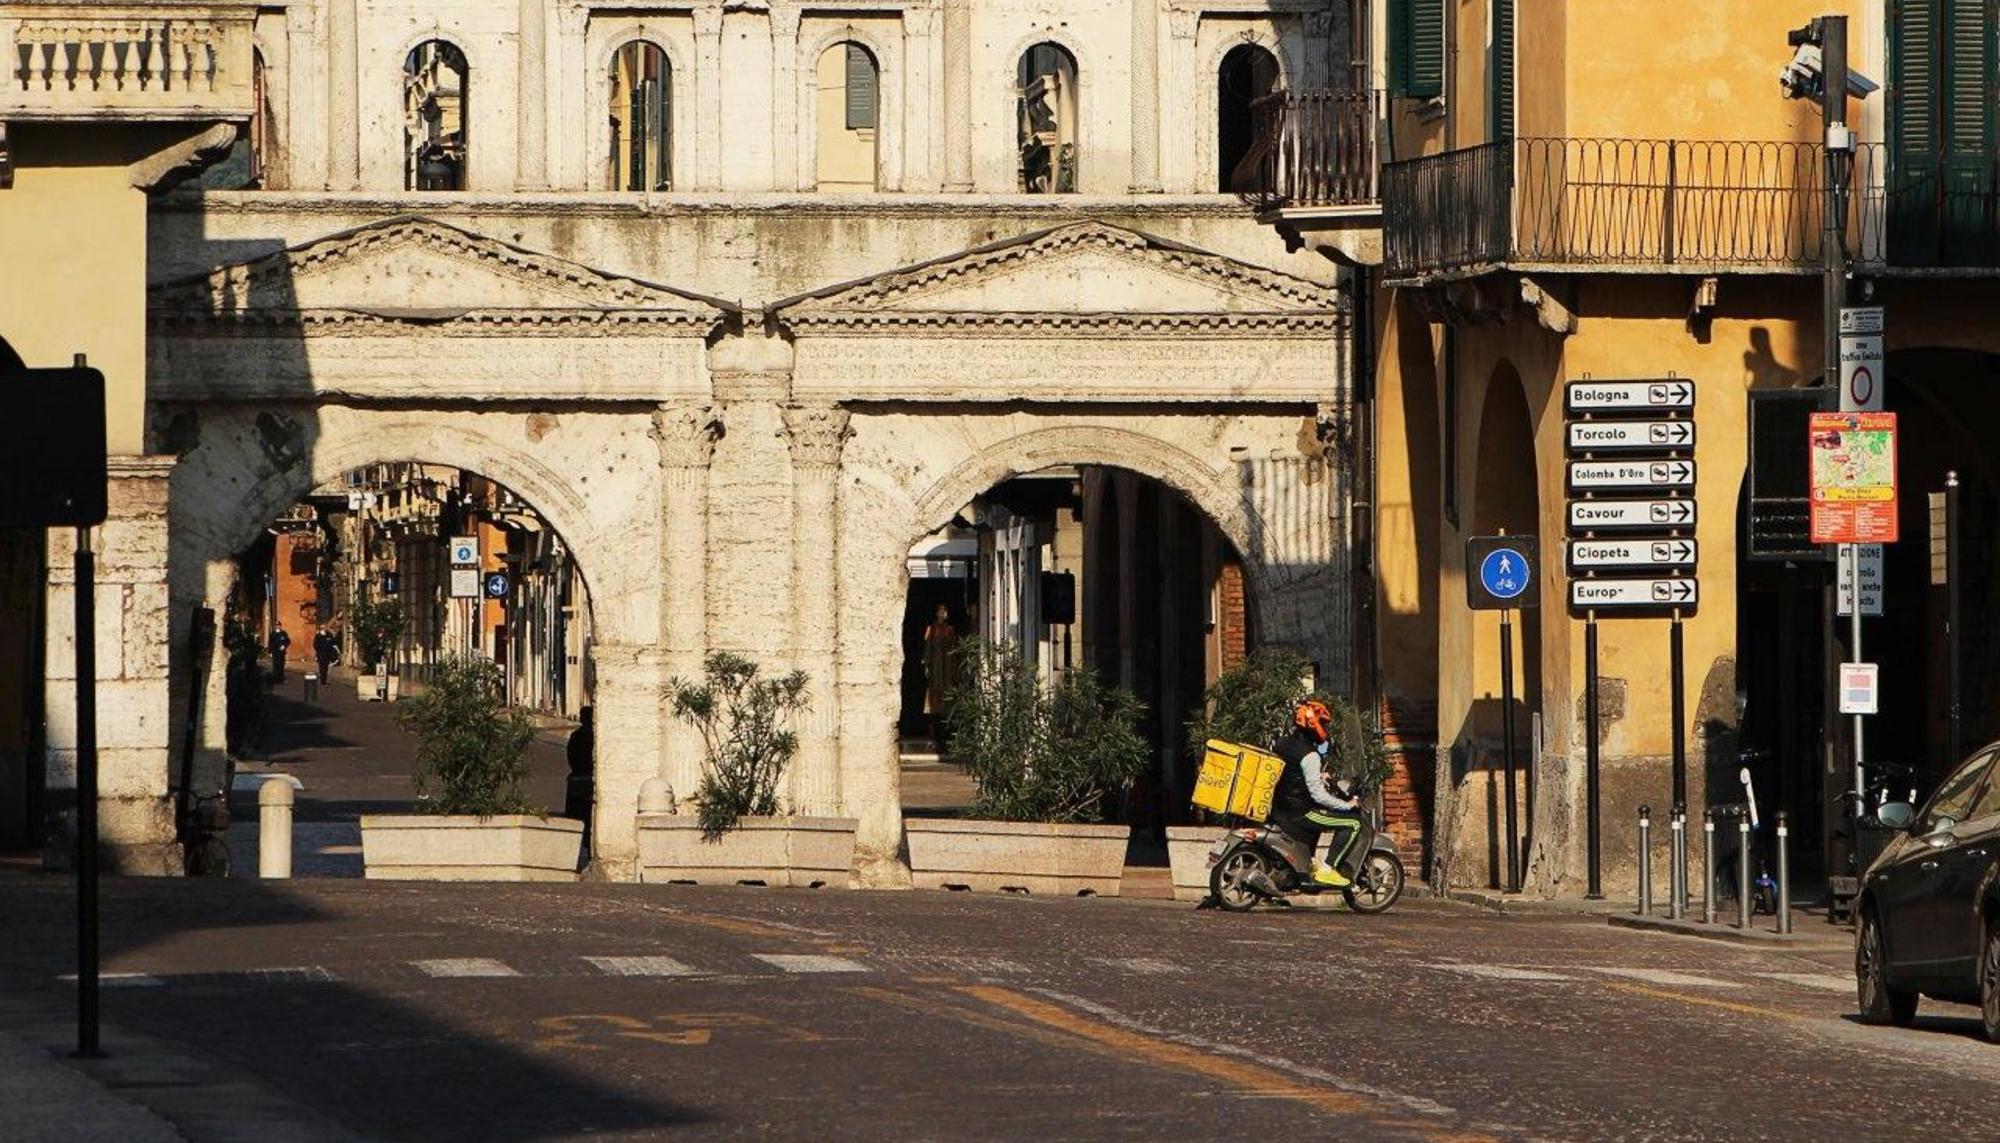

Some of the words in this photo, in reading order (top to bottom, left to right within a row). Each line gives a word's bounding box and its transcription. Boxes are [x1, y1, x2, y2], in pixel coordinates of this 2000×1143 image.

[1574, 390, 1629, 402] Bologna
[1576, 429, 1626, 440] Torcolo
[1576, 469, 1614, 479] Colomba
[1620, 468, 1645, 478] D'Oro
[1576, 508, 1624, 518] Cavour
[1577, 547, 1630, 559] Ciopeta
[1258, 764, 1278, 815] Glovo
